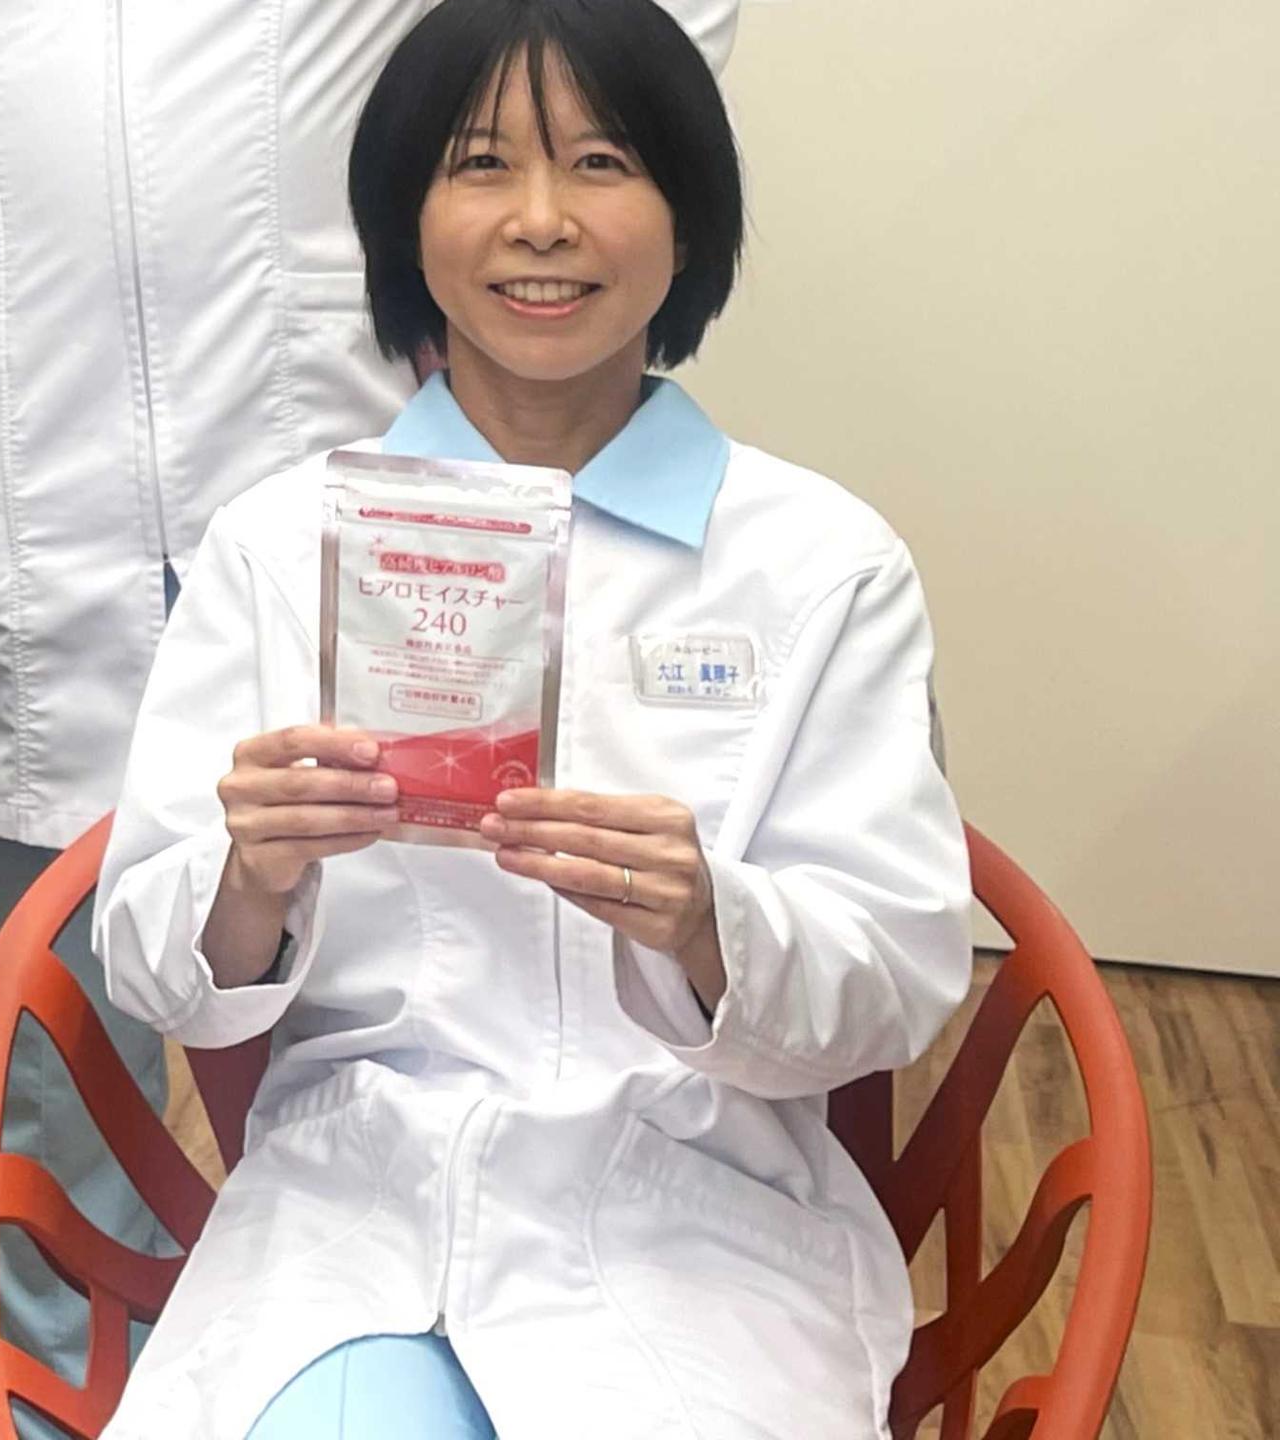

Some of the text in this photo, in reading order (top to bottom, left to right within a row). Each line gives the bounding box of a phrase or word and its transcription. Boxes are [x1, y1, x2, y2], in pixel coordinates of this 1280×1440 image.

[358, 577, 525, 610] ヒアロモイスチャー
[411, 608, 467, 637] 240
